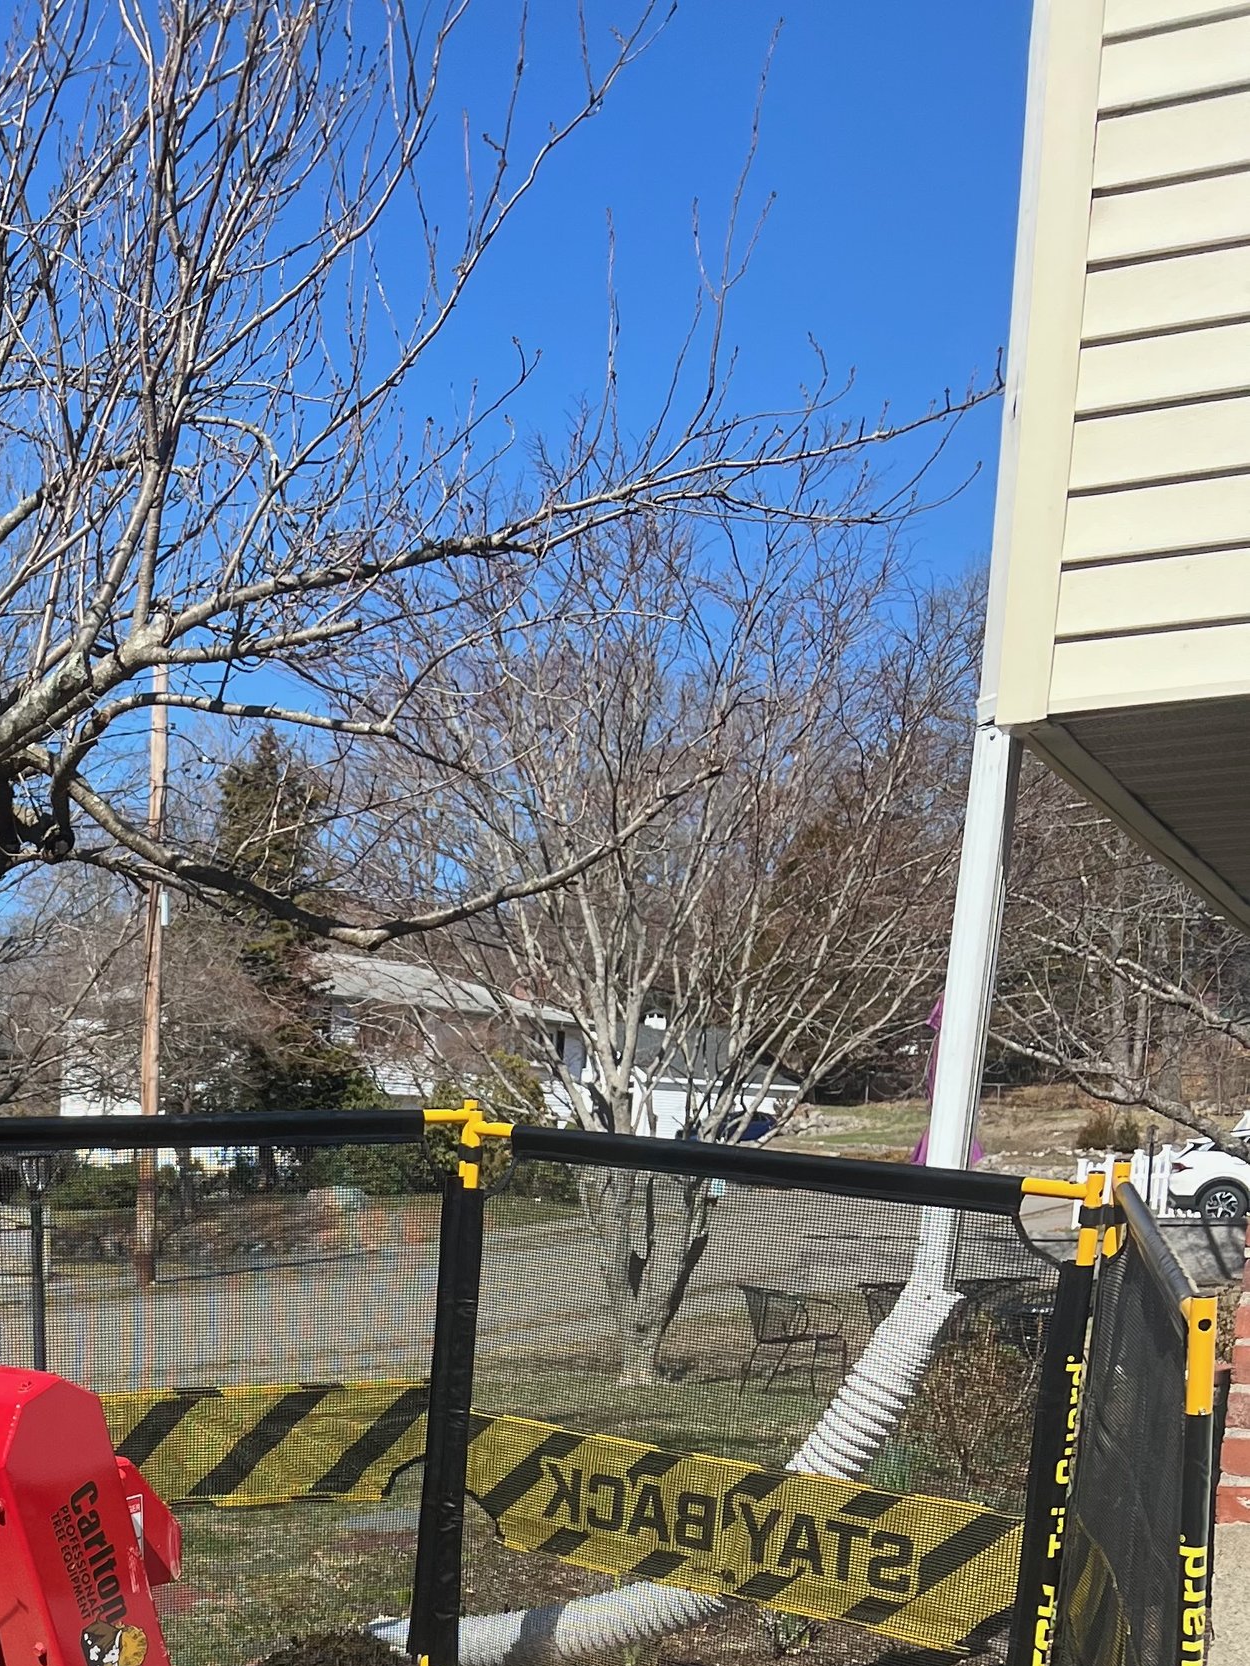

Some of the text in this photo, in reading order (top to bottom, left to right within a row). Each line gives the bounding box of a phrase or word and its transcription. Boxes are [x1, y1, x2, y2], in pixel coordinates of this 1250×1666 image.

[51, 1512, 91, 1621] TREE EQUIPMENT
[59, 1504, 102, 1622] PROFESSIONAL
[71, 1480, 127, 1626] Carlton
